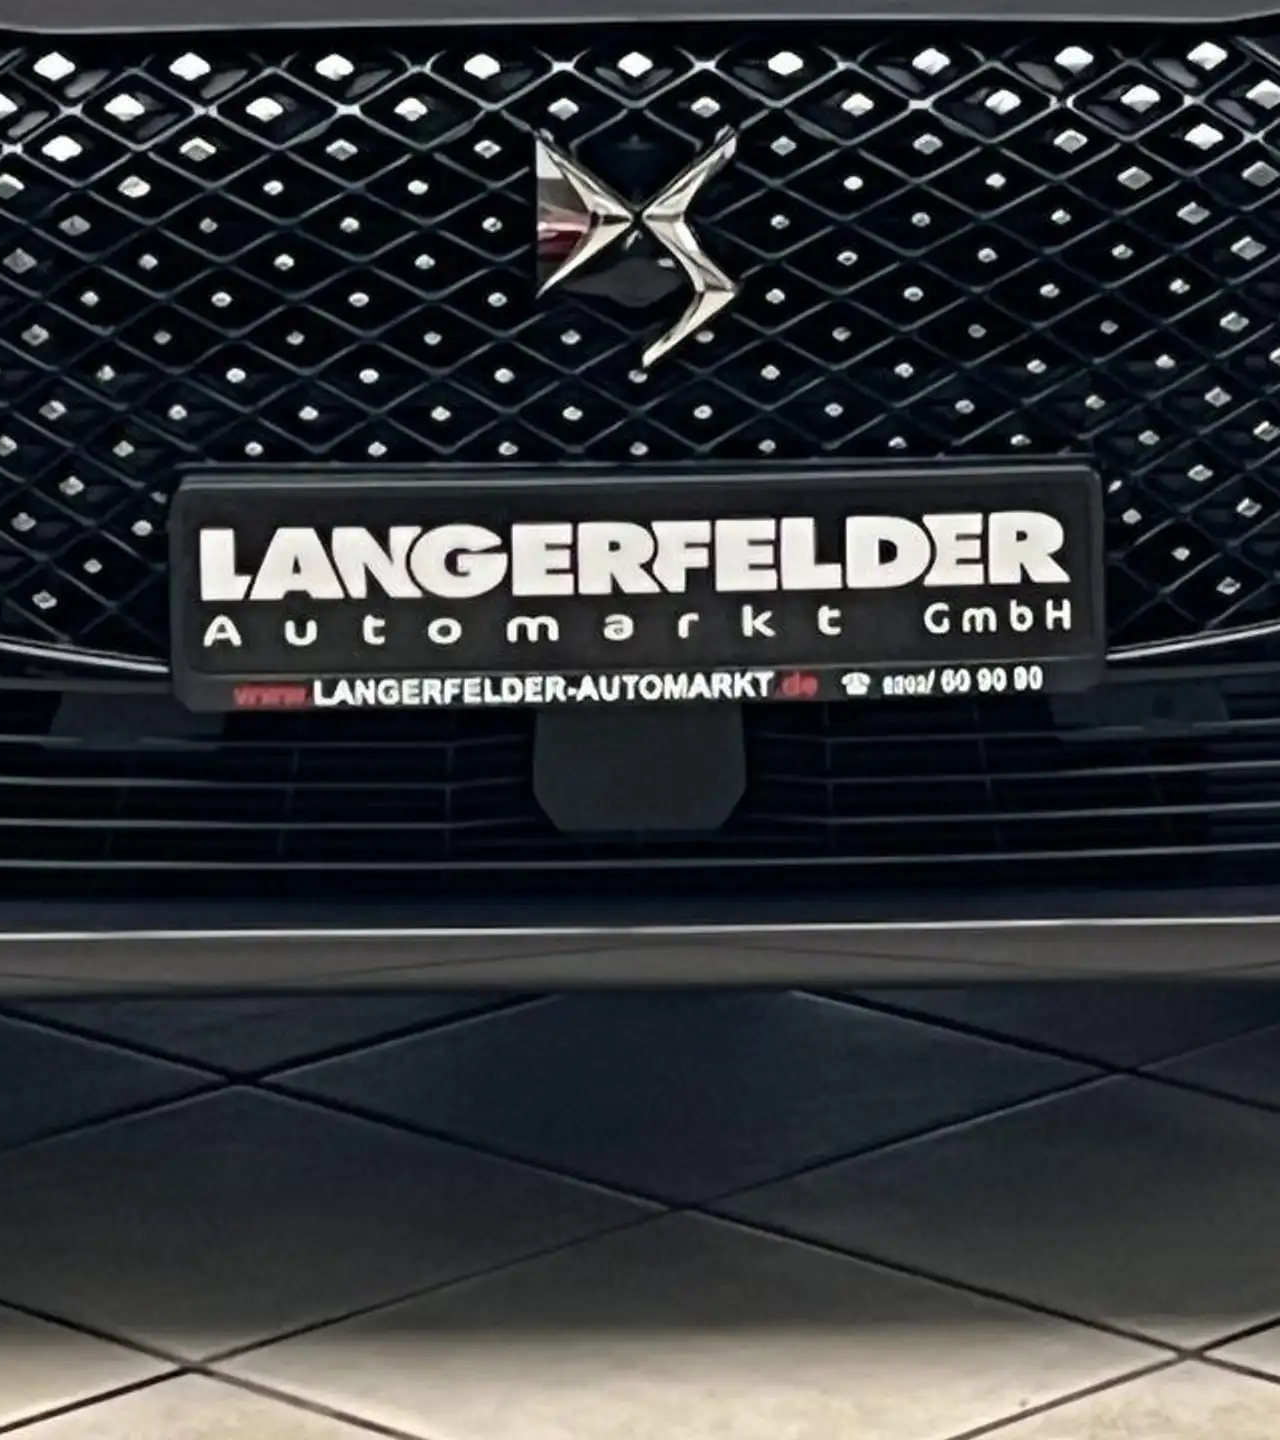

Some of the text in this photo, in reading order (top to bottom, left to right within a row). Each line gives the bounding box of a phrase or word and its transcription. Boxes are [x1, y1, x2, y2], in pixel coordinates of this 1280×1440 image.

[199, 511, 1071, 602] LANGERFELDER
[203, 597, 1072, 648] Automarkt GmbH
